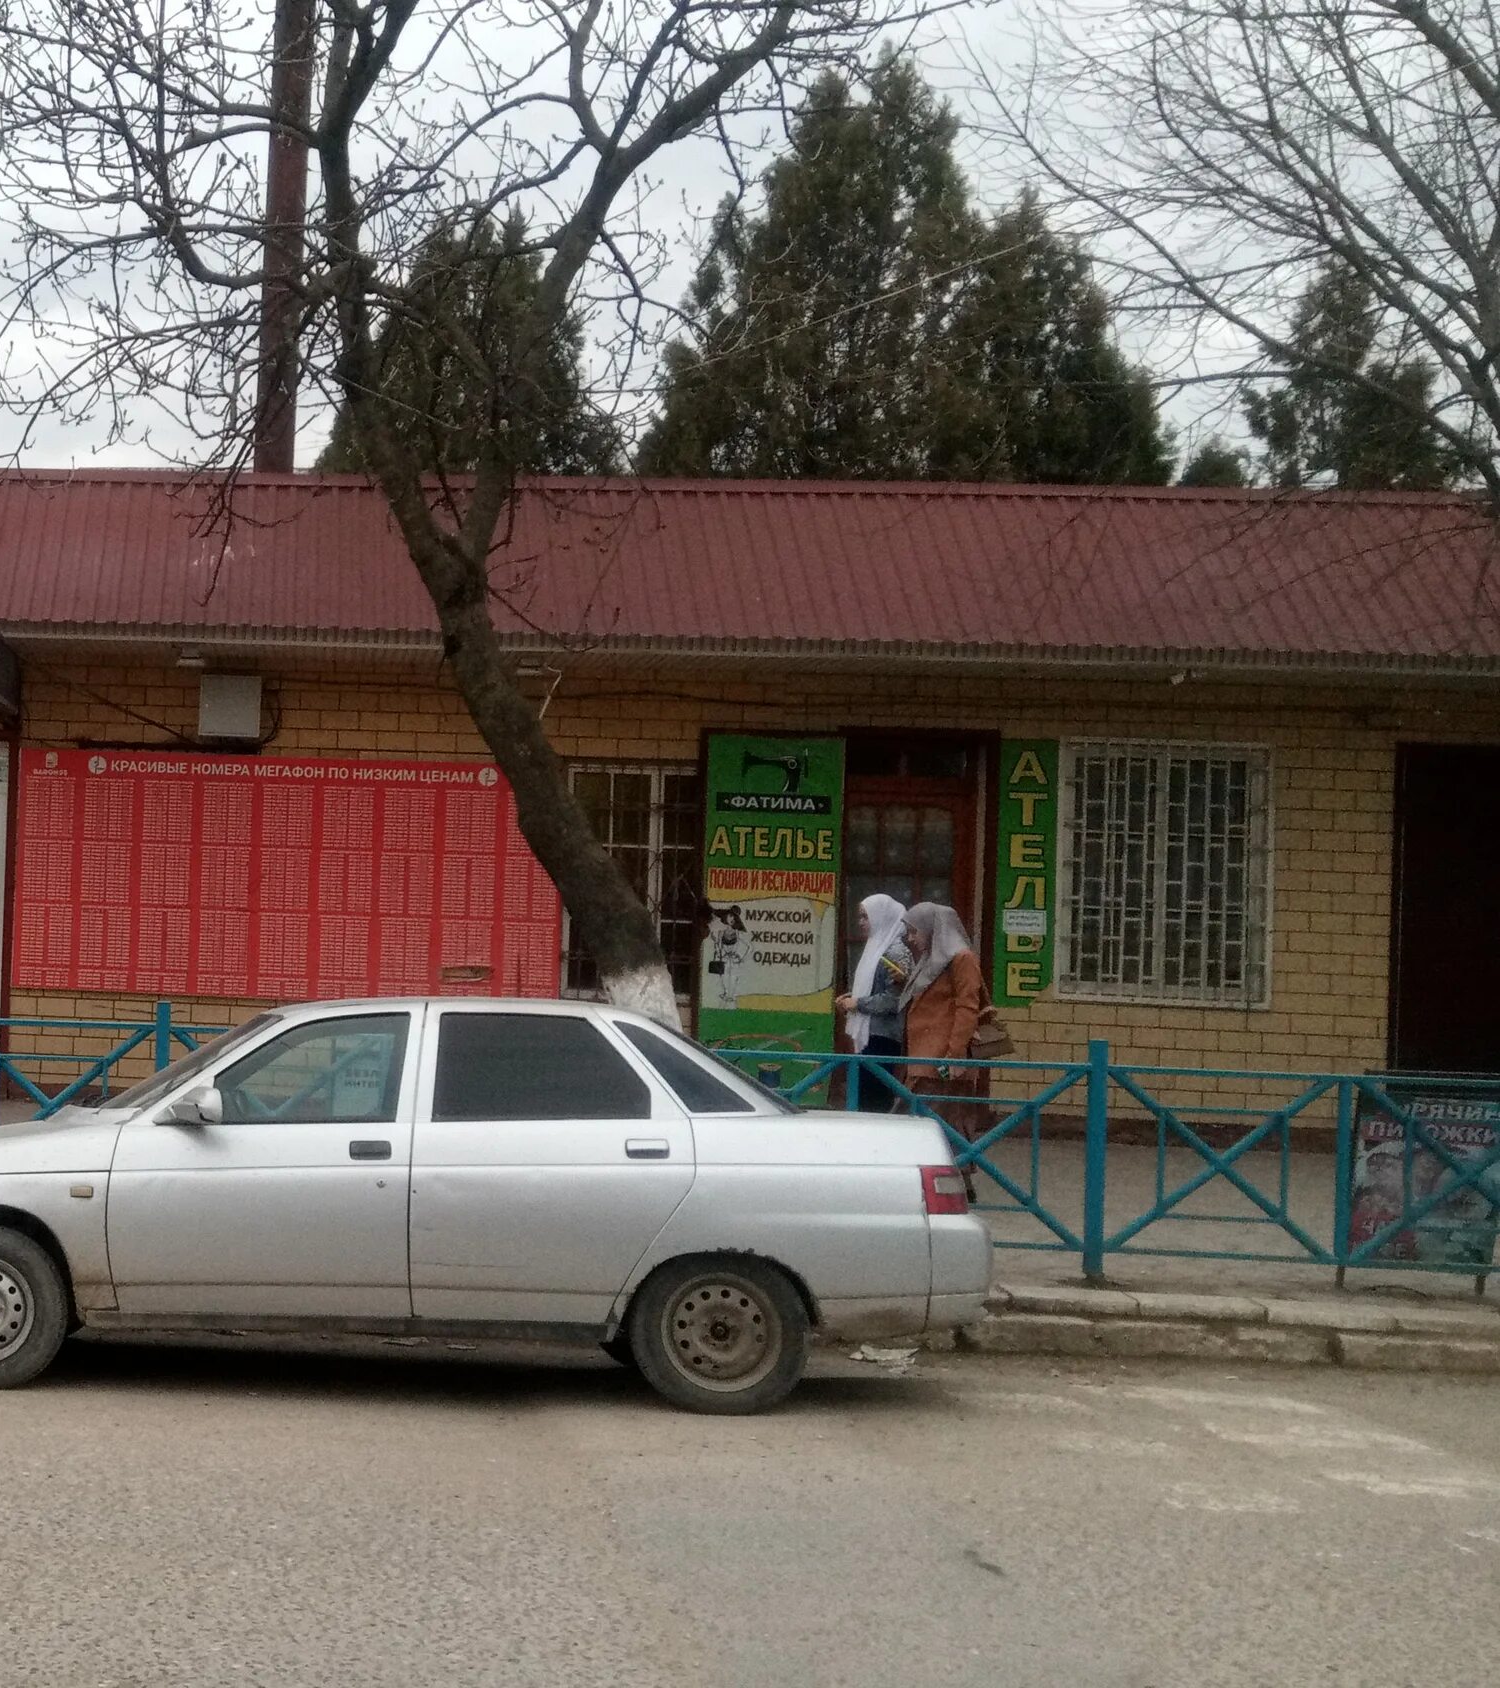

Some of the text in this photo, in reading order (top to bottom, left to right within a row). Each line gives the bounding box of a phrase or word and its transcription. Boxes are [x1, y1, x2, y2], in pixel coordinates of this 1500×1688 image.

[111, 759, 474, 784] КРАСИВЫЕ НОМЕРА МЕГАФОН ПО НИЗКИМ ЦЕНАМ
[730, 795, 816, 811] ФАТИМА
[709, 825, 834, 860] АТЕЛЬЕ
[709, 868, 834, 897] ПОШИВ И РЕСТАВРАЦИЯ
[745, 908, 812, 924] МУЖСКОЙ
[751, 930, 814, 945] ЖЕНСКОЙ
[753, 951, 811, 968] ОДЕЖДЫ
